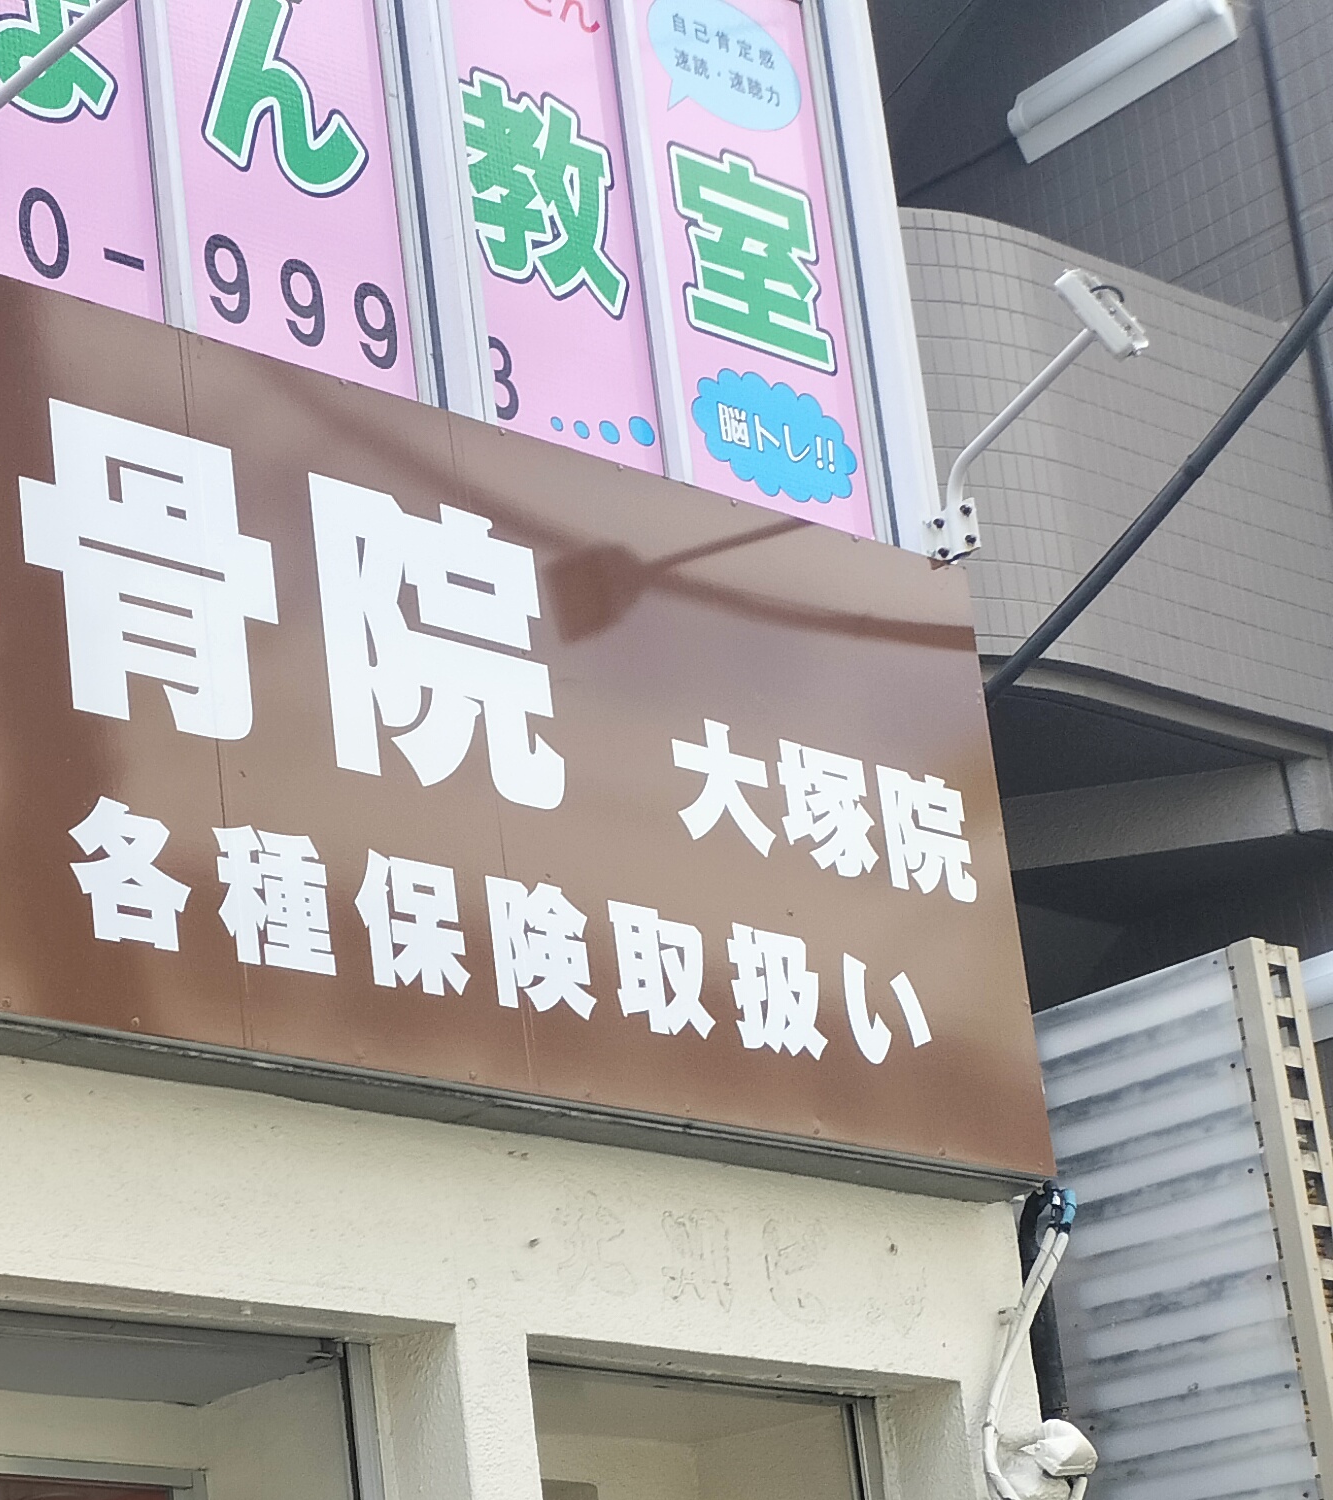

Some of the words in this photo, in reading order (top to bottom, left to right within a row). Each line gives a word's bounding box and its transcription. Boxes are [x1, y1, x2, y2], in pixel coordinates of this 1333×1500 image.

[671, 717, 978, 903] 大塚院
[69, 796, 933, 1065] 各種保険取扱い
